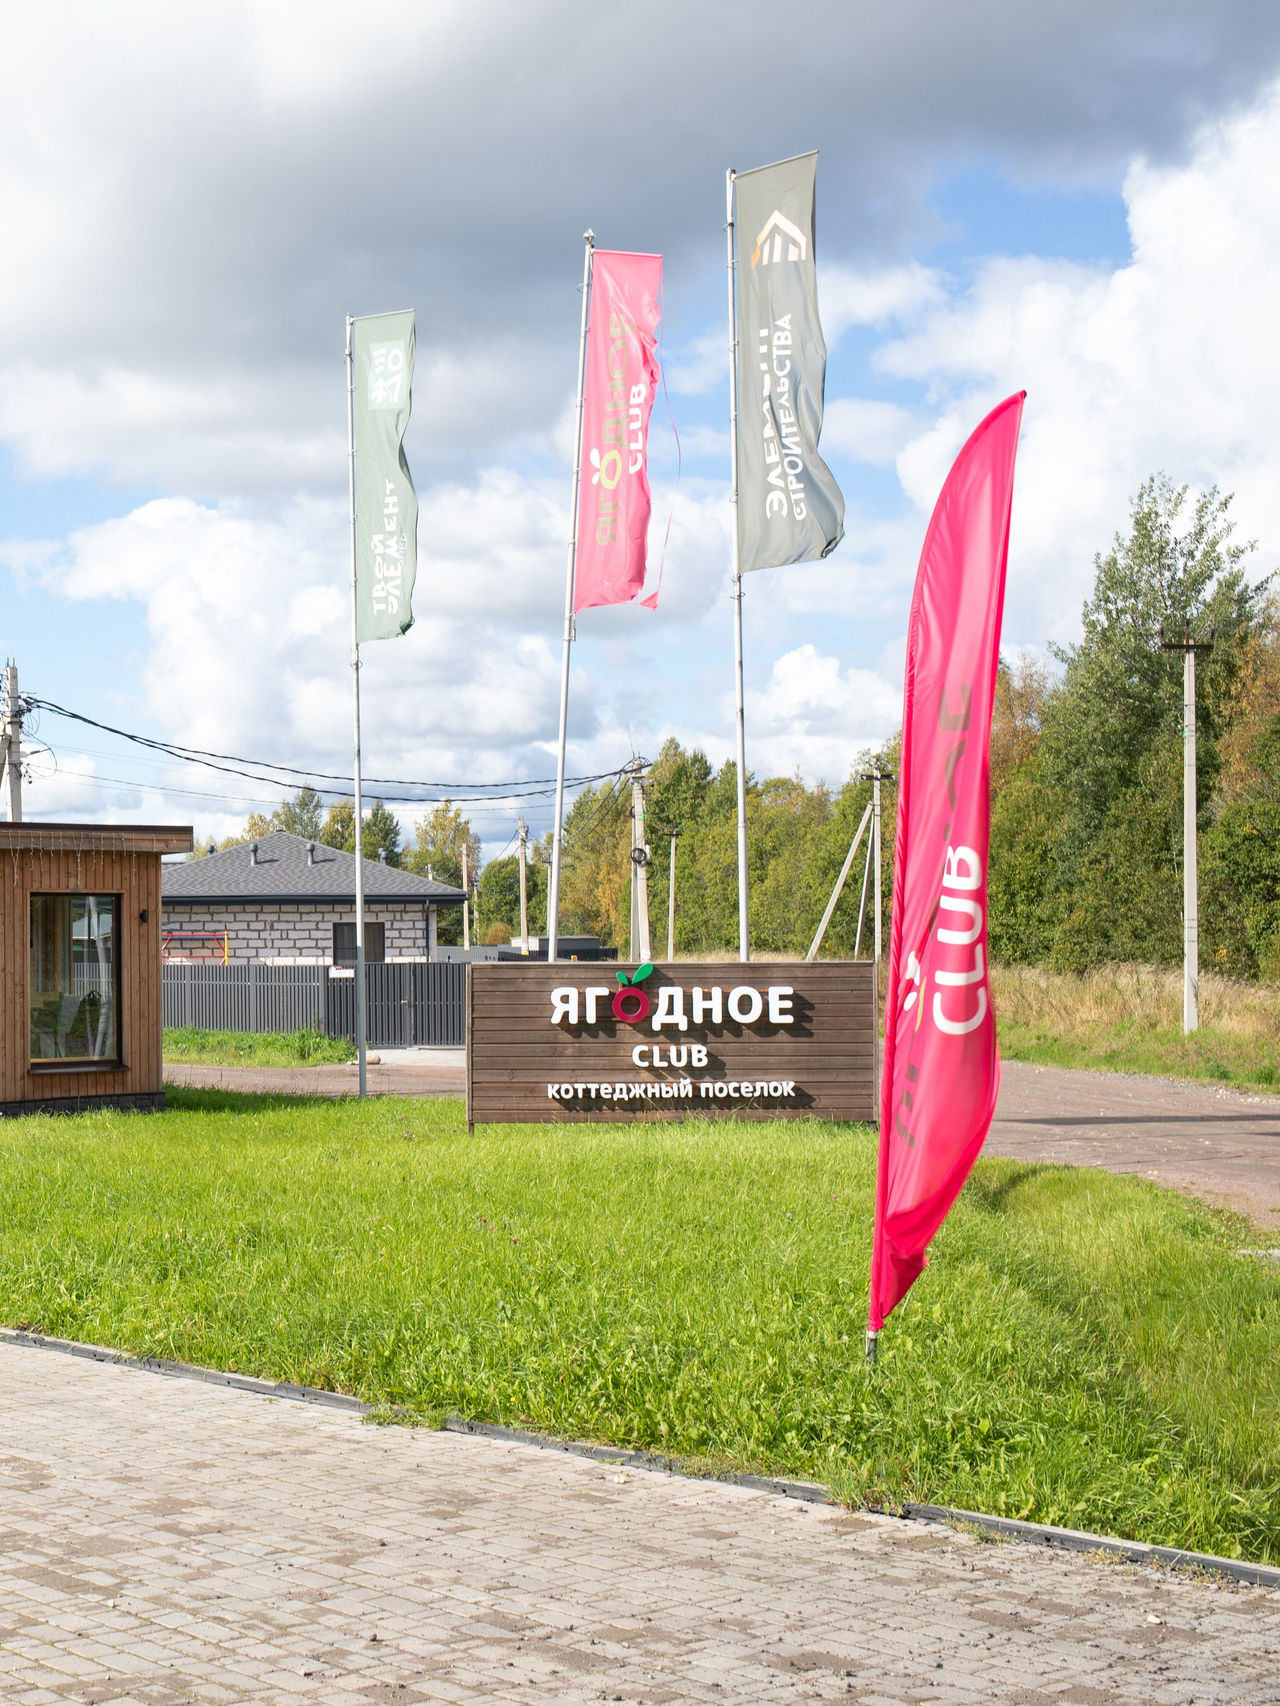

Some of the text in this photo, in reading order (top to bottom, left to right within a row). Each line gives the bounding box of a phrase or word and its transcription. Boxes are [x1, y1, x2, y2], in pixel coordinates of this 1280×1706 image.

[628, 382, 646, 475] CLUB
[371, 533, 388, 616] ТВОЙ
[932, 845, 987, 1035] CLUB
[549, 985, 795, 1031] ЯГОДНОЕ
[631, 1044, 709, 1068] CLUB
[547, 1078, 796, 1102] коттеджный поселок
